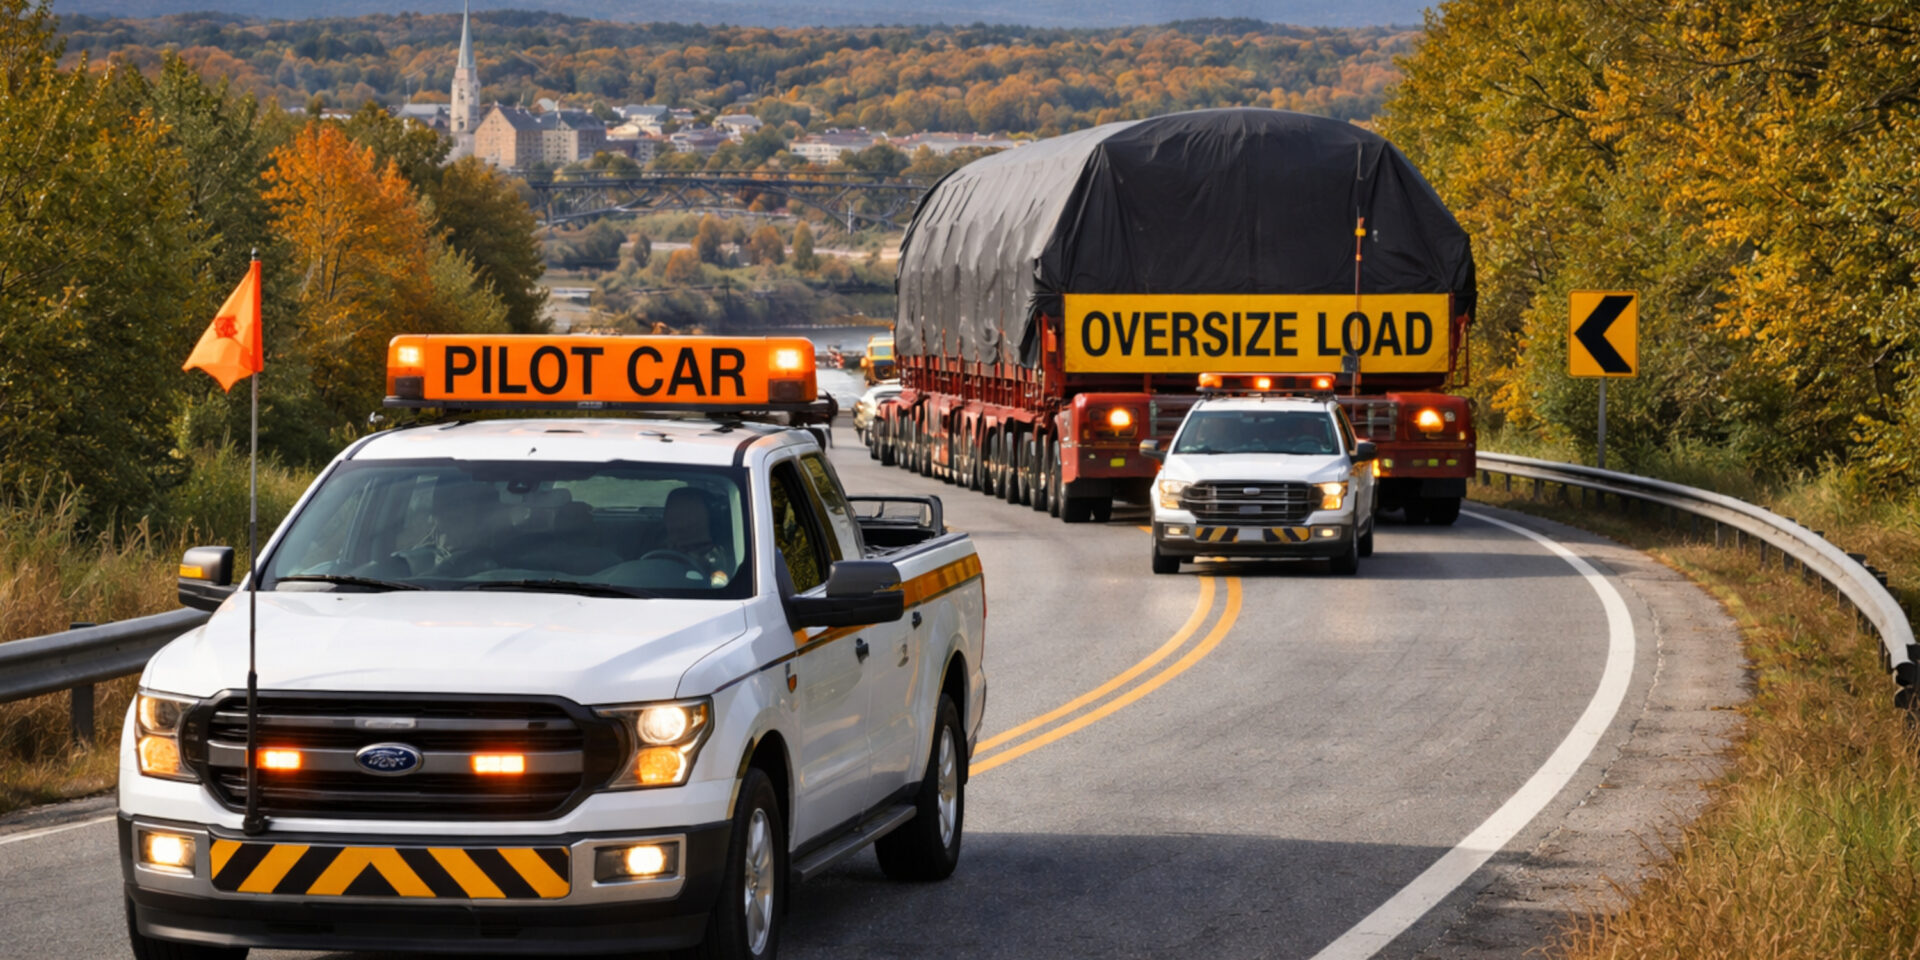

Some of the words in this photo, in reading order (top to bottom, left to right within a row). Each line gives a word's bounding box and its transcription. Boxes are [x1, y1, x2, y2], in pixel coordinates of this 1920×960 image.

[1081, 310, 1298, 357] OVERSIZE
[1317, 311, 1433, 357] LOAD
[444, 345, 604, 395] PILOT
[627, 346, 746, 397] CAR
